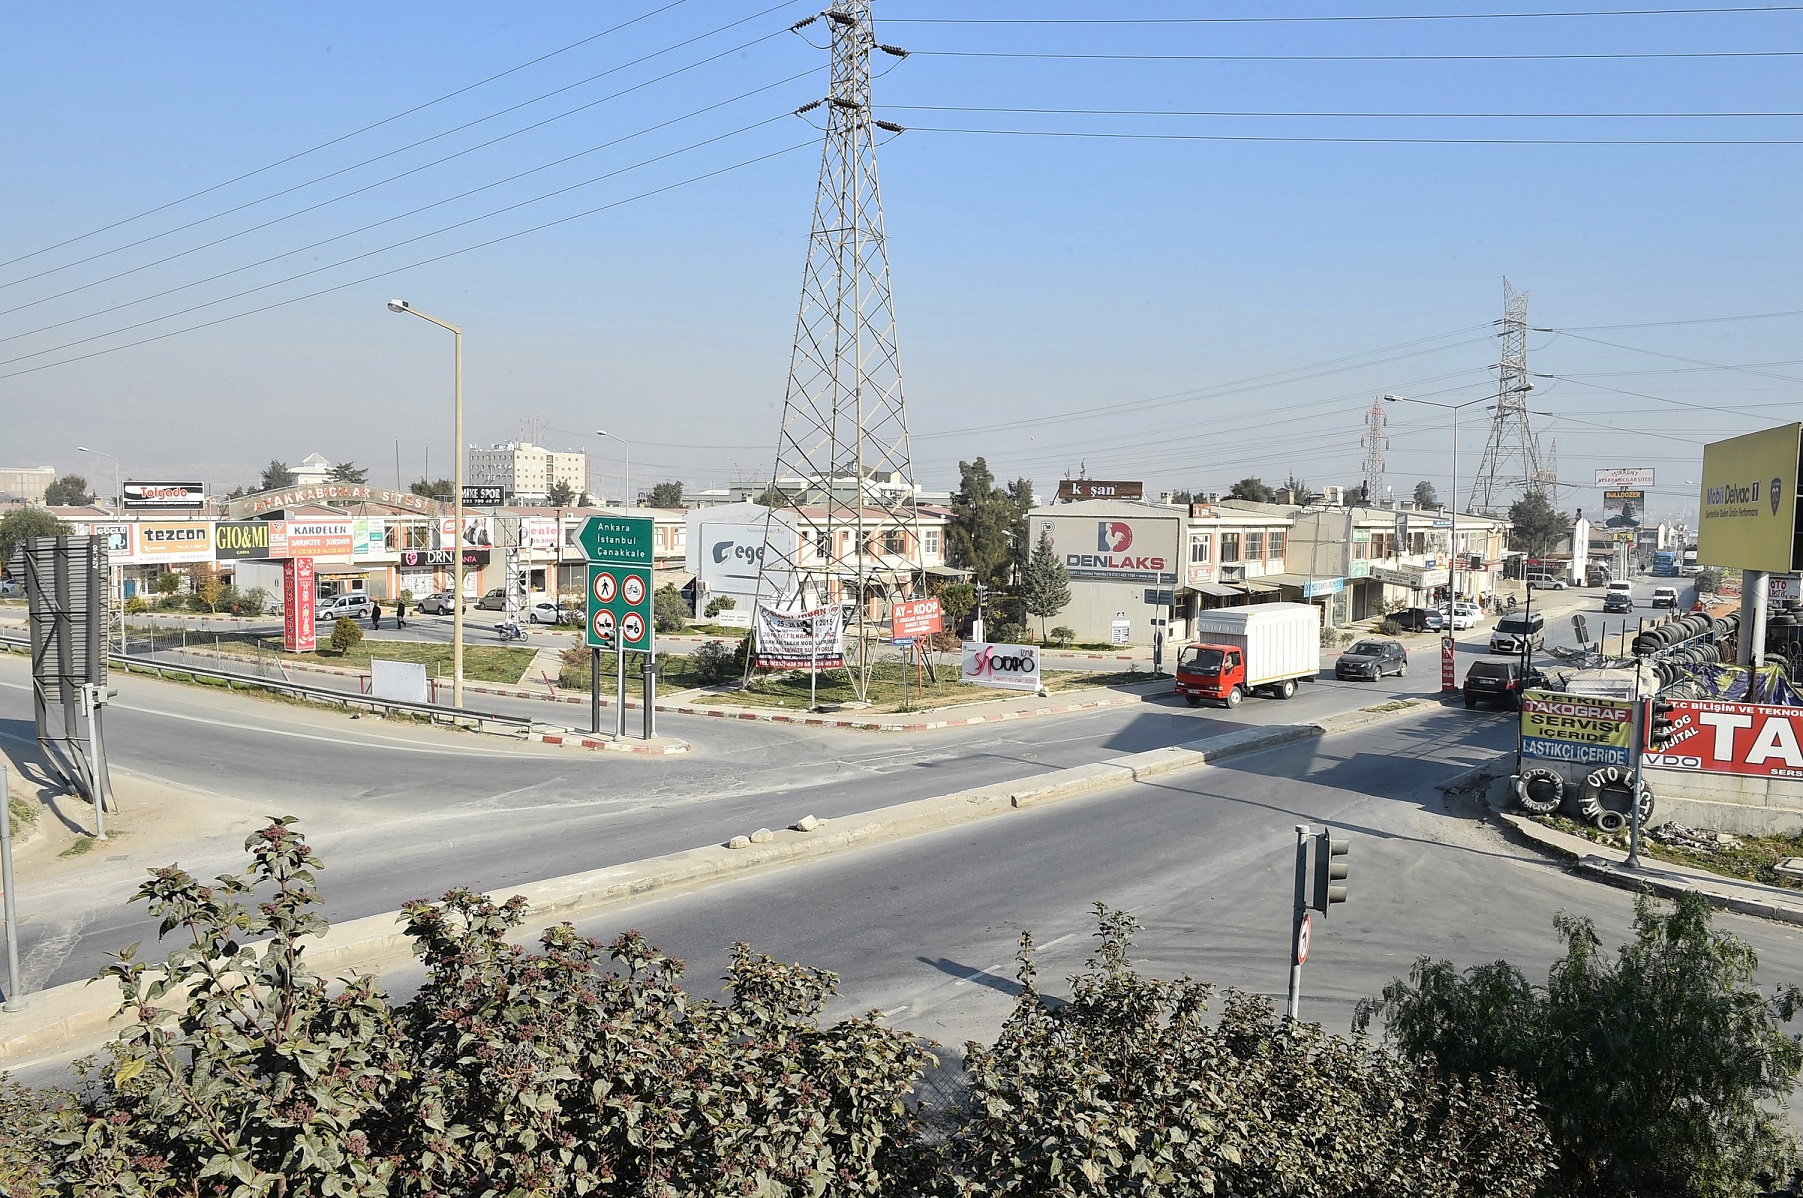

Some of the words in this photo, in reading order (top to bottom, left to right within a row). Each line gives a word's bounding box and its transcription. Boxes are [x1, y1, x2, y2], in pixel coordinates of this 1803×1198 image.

[1707, 485, 1725, 505] Mobil
[1725, 484, 1749, 504] Delvac
[294, 526, 346, 534] KARDELEN
[598, 523, 630, 531] Ankara
[217, 526, 268, 549] GIO&MI
[597, 534, 636, 544] İstanbul
[427, 551, 453, 563] DRN
[597, 547, 645, 558] Çanakkale
[1067, 554, 1165, 570] DENLAKS
[1770, 581, 1786, 589] OTO
[895, 606, 906, 617] AY
[914, 602, 938, 615] KOOP
[1526, 701, 1626, 720] TAKOGRAF
[1691, 701, 1734, 712] BİLİŞİM
[1738, 706, 1754, 714] VE
[1645, 754, 1699, 767] VDO
[1523, 768, 1546, 780] OTO
[1587, 767, 1618, 788] OTO
